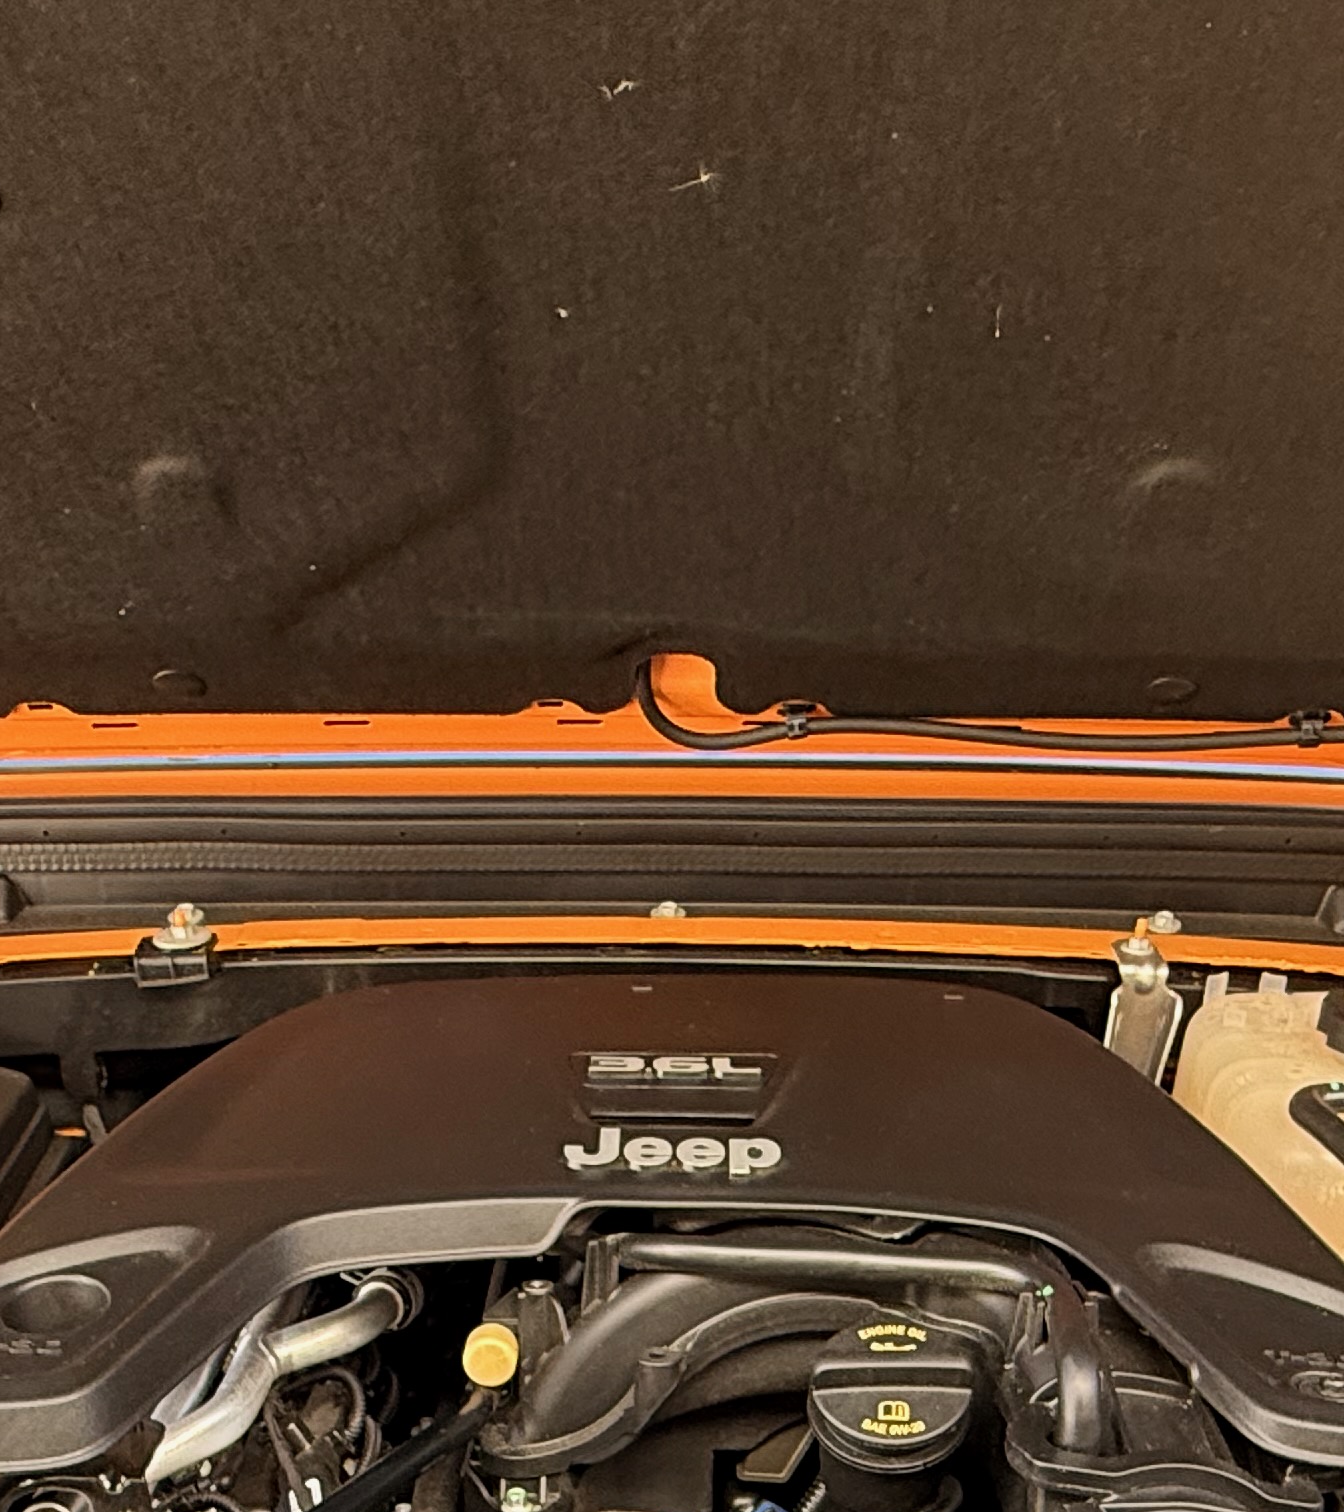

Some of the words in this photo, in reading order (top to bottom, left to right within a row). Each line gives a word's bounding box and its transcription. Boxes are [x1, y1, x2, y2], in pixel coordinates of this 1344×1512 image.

[588, 1056, 762, 1079] 3.6L
[564, 1127, 782, 1175] Jeep
[857, 1325, 906, 1340] ENGINE
[907, 1327, 927, 1342] OIL
[861, 1418, 887, 1435] SAE
[889, 1420, 926, 1436] 0W-20
